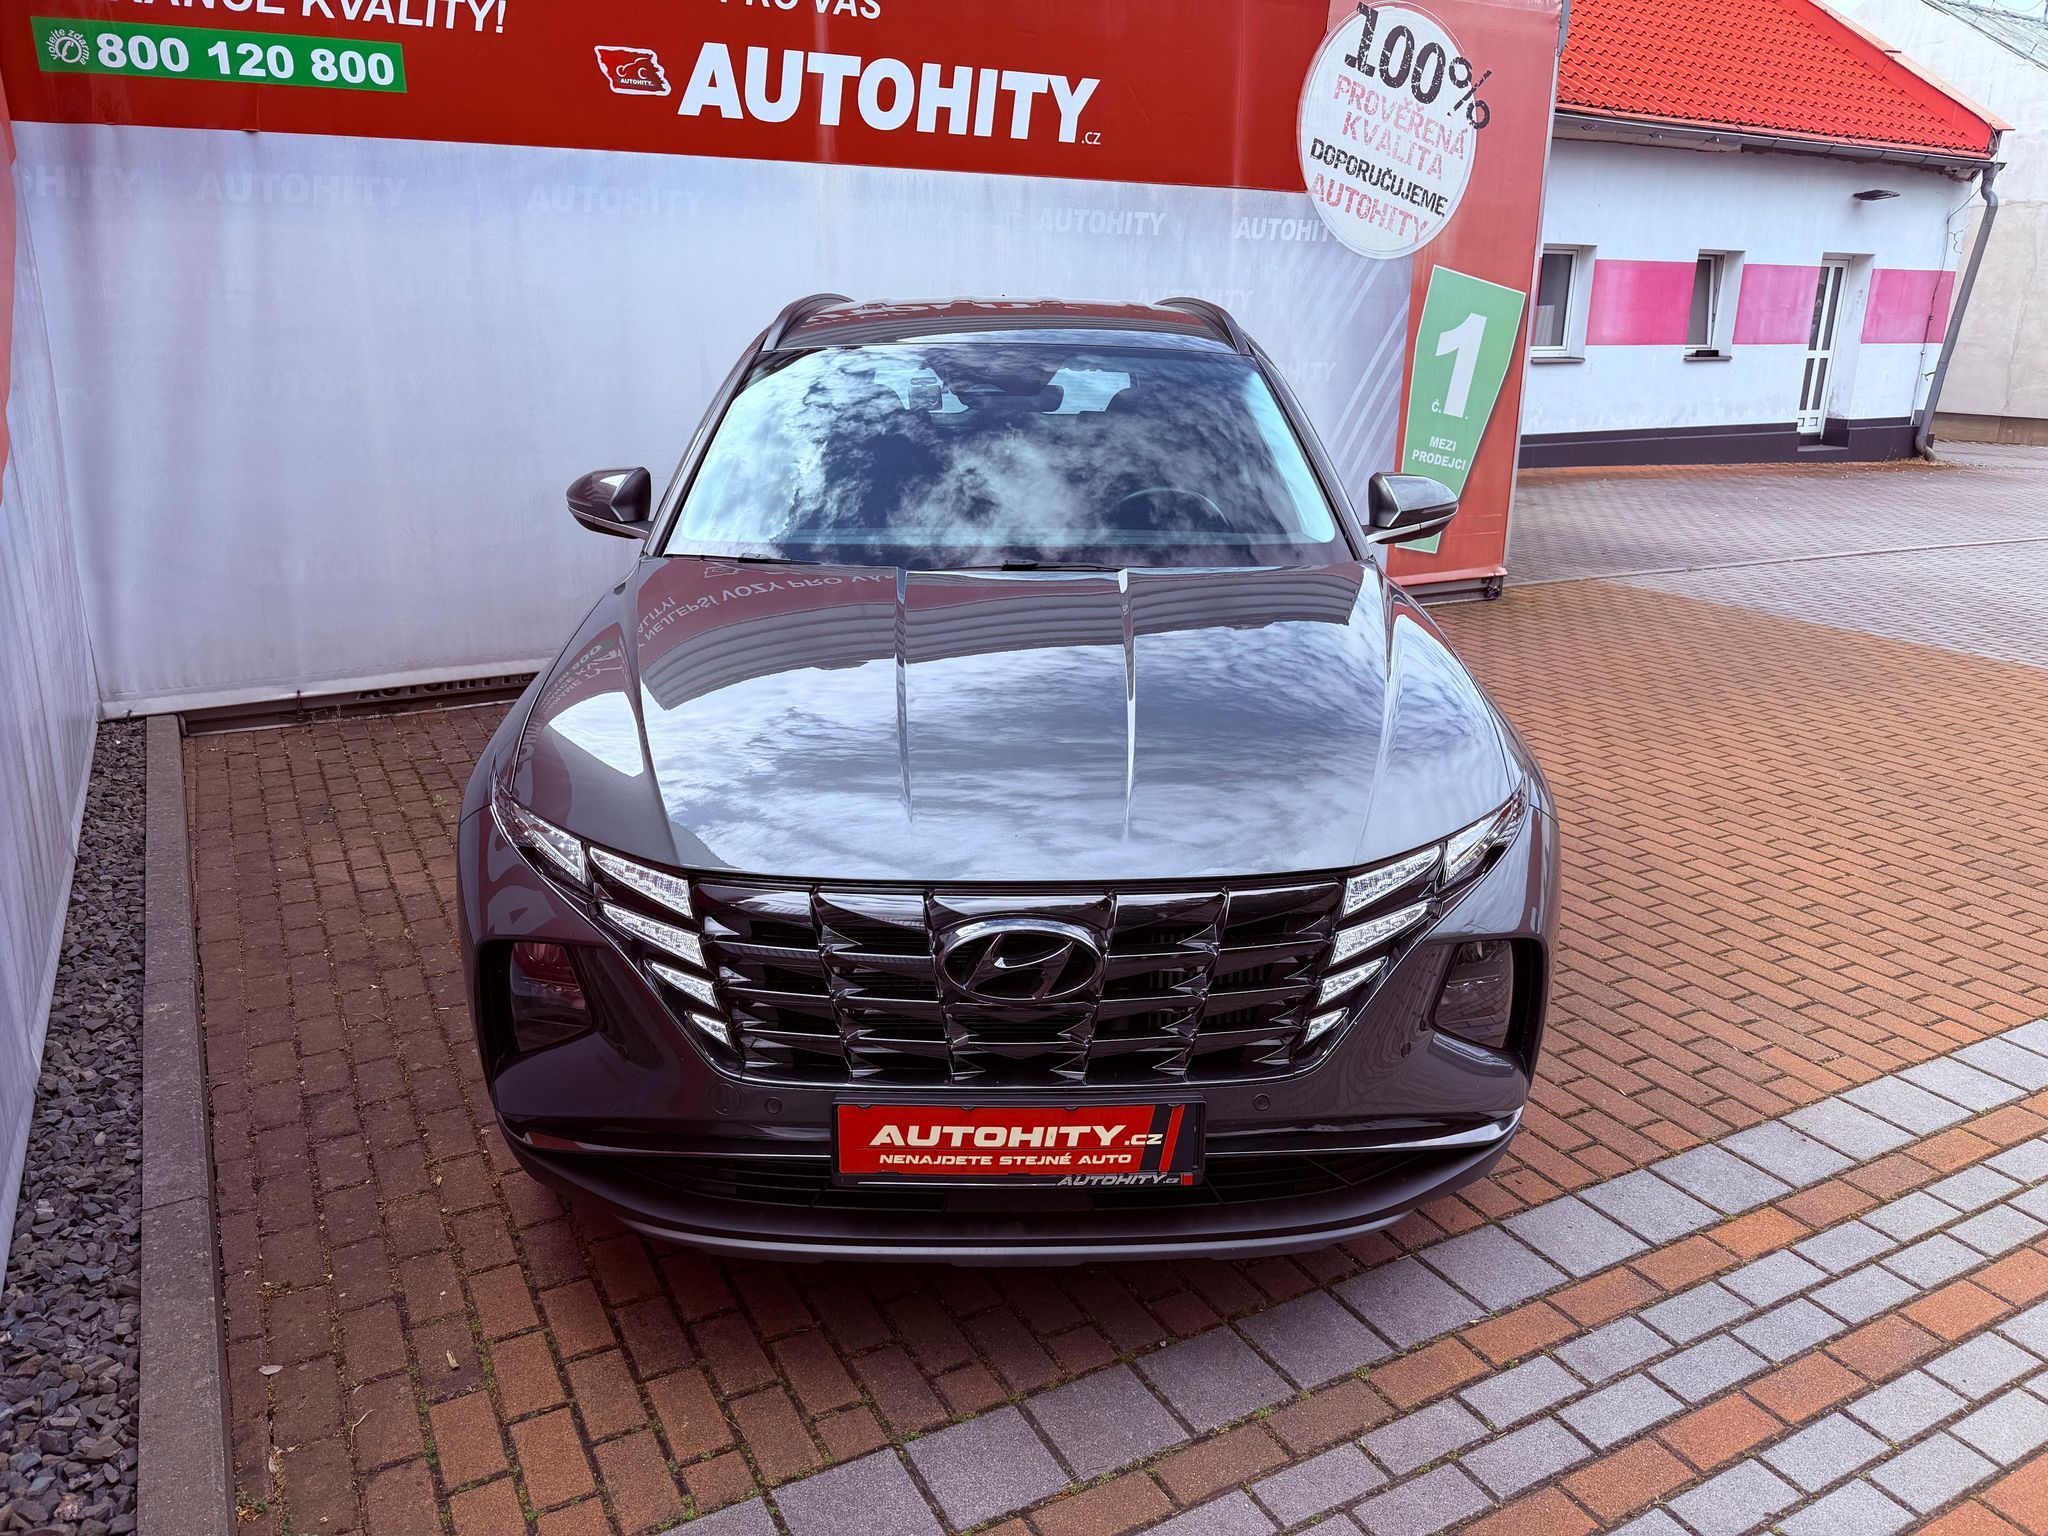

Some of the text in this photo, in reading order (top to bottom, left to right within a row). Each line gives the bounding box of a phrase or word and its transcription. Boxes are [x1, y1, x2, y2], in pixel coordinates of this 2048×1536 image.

[96, 33, 394, 86] 800 120 800
[1344, 1, 1493, 130] 100%
[1333, 73, 1468, 160] PROVĚŘENÁ
[1342, 111, 1443, 181] KVALITA
[1309, 137, 1449, 218] DOPORUČUJEME
[1312, 172, 1430, 244] AUTOHITY
[1037, 207, 1167, 237] AUTOHITY
[1234, 215, 1340, 242] AUTOHIT
[1411, 449, 1467, 471] PRODEJCI
[1429, 436, 1457, 452] MEZI
[879, 1152, 1132, 1166] NENAJDETE STEJNÉ AUTO
